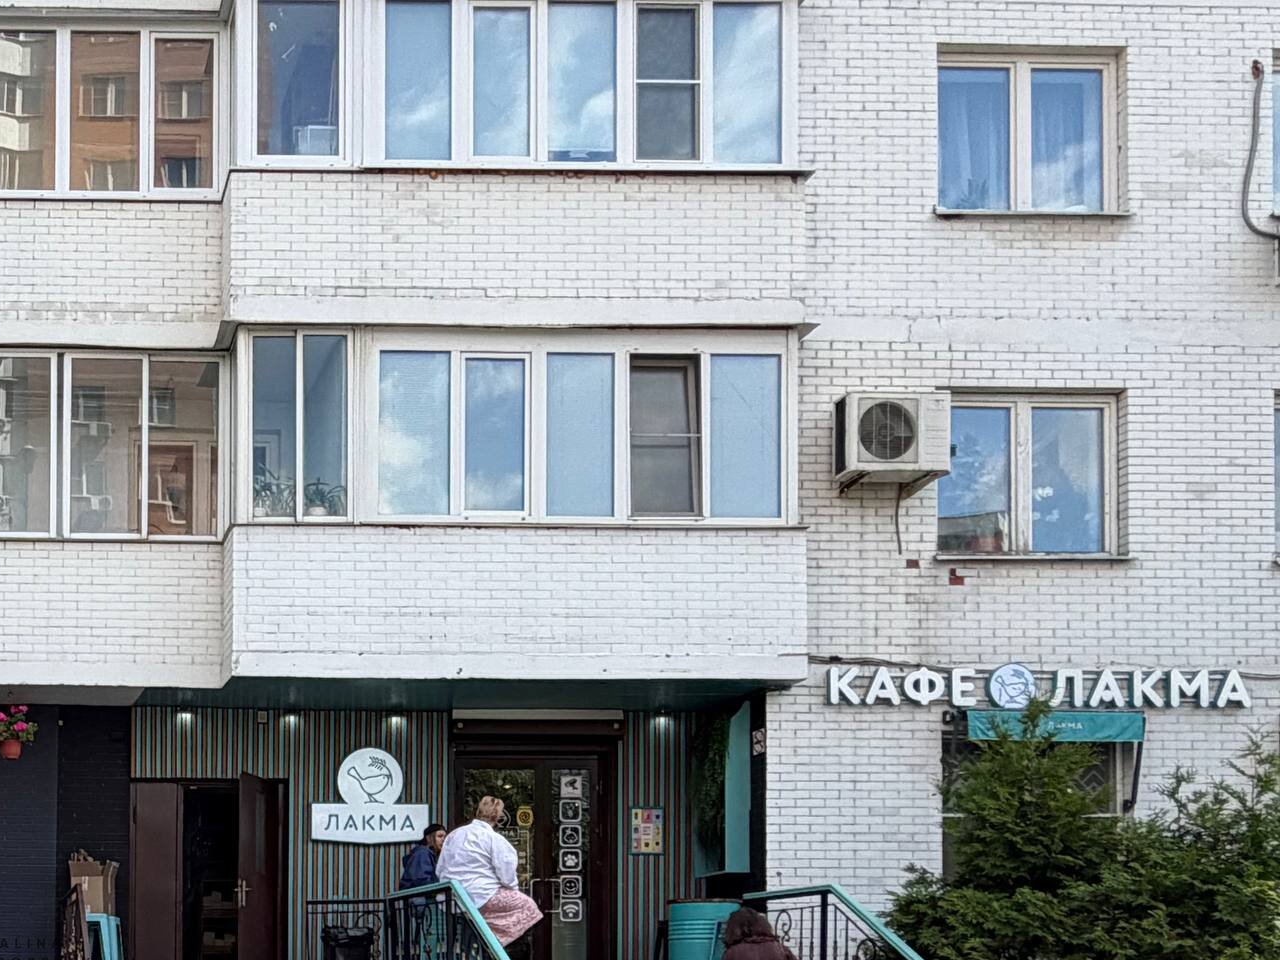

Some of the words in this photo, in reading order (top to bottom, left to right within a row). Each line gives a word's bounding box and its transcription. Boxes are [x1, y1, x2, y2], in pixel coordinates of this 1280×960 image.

[828, 666, 977, 706] КАФЕ
[1049, 668, 1252, 708] ЛАКМА
[324, 813, 416, 832] ЛАКМА
